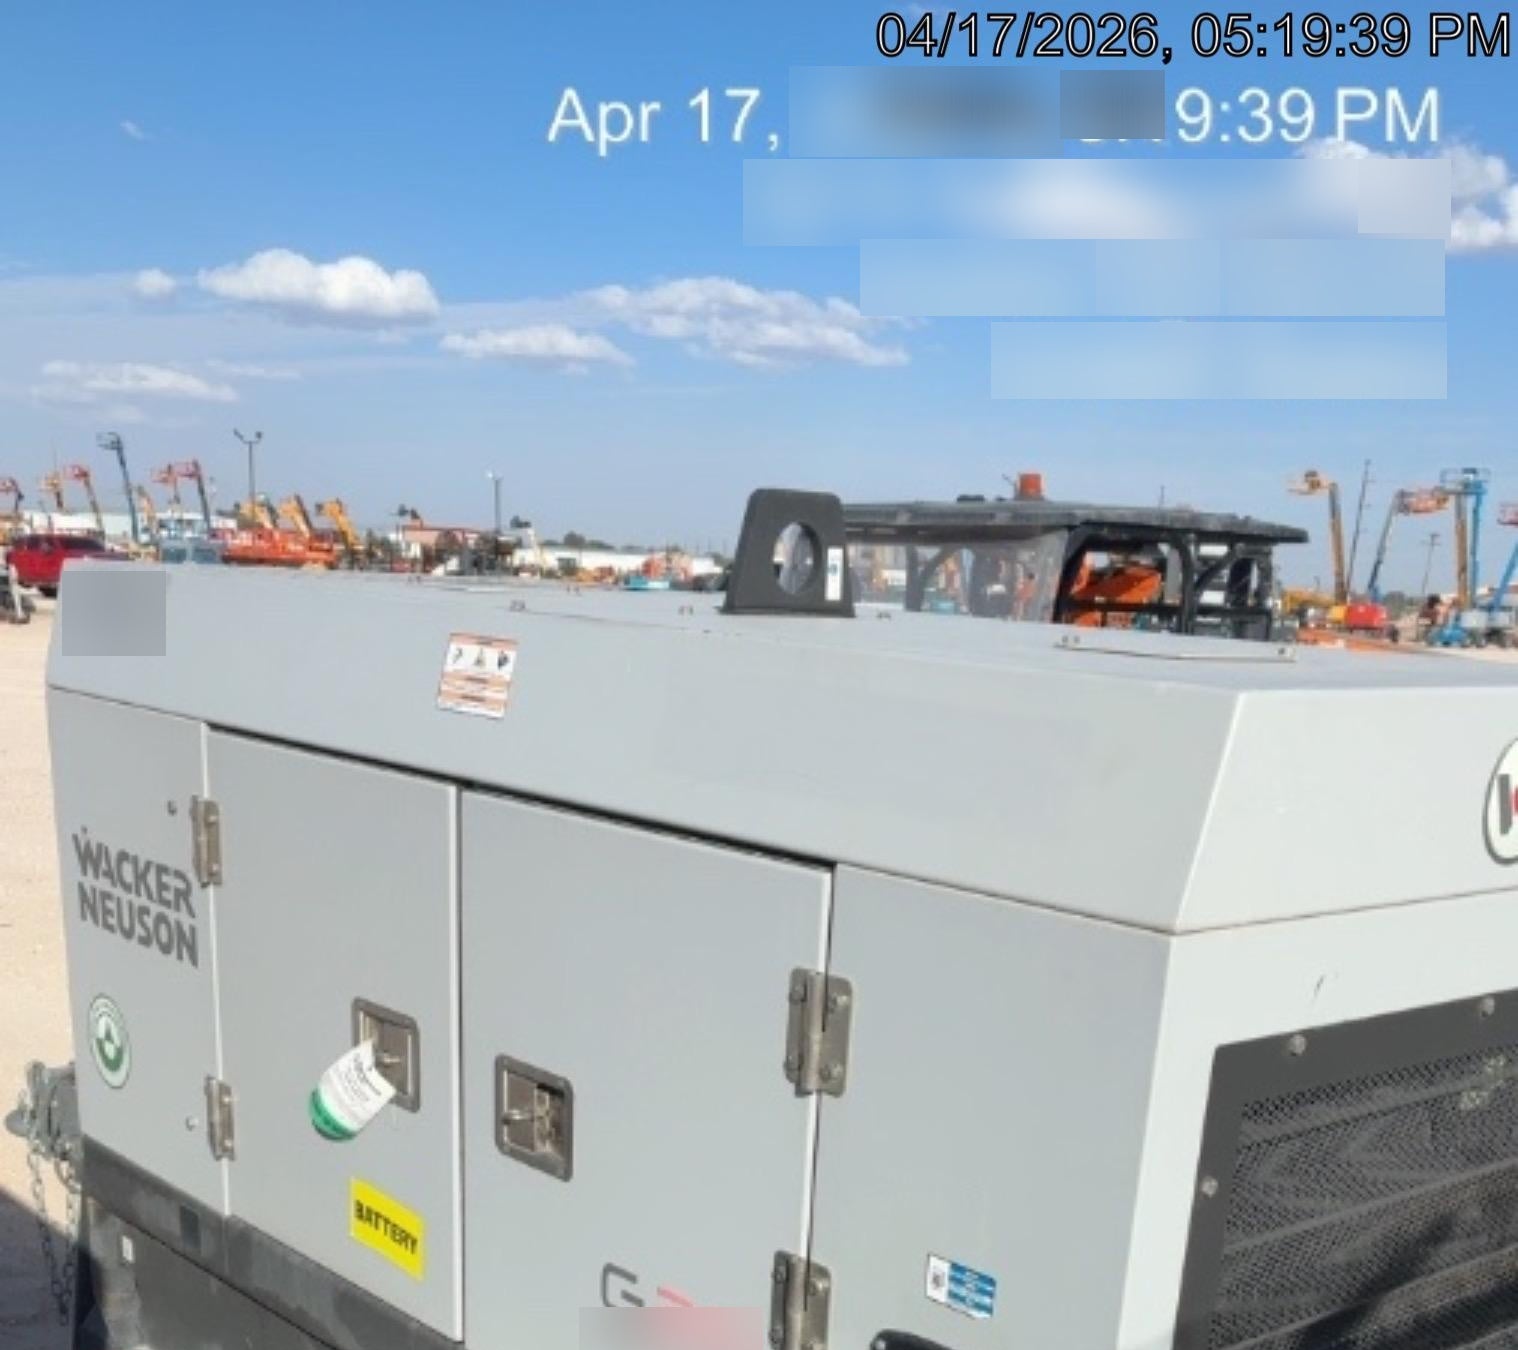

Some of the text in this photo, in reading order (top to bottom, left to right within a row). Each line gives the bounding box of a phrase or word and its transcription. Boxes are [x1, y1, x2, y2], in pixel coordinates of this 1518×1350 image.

[72, 832, 196, 919] WACKER
[77, 881, 199, 969] NEUSON
[354, 1199, 419, 1255] BATTERY
